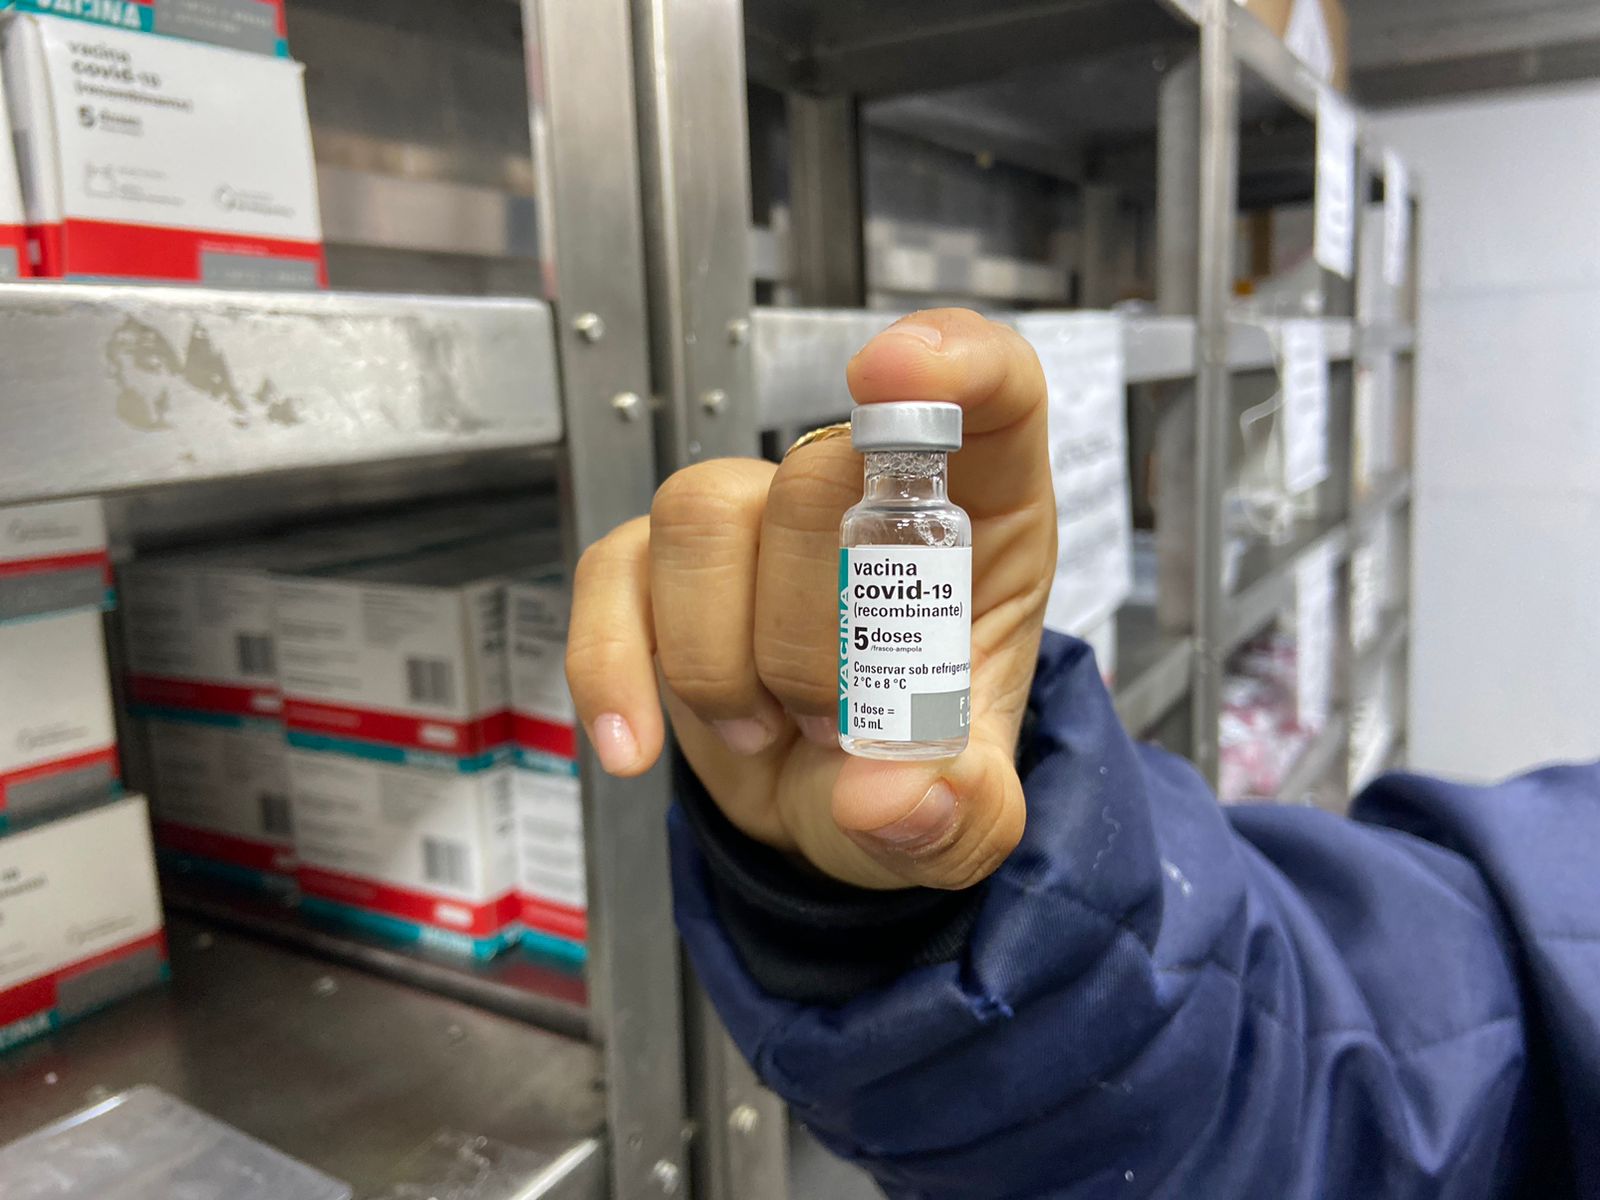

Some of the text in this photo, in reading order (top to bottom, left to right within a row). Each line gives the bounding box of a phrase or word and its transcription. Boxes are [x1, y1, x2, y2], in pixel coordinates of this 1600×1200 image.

[854, 558, 917, 576] vacina
[854, 580, 952, 600] covid-19
[854, 602, 963, 618] (recombinante)
[839, 586, 849, 701] VACINA
[854, 626, 922, 650] 5 doses
[854, 661, 905, 675] Conservar
[908, 664, 928, 675] sob
[874, 679, 880, 688] e
[854, 702, 858, 713] 1
[860, 703, 884, 715] dose
[853, 716, 883, 730] 0,5 mL
